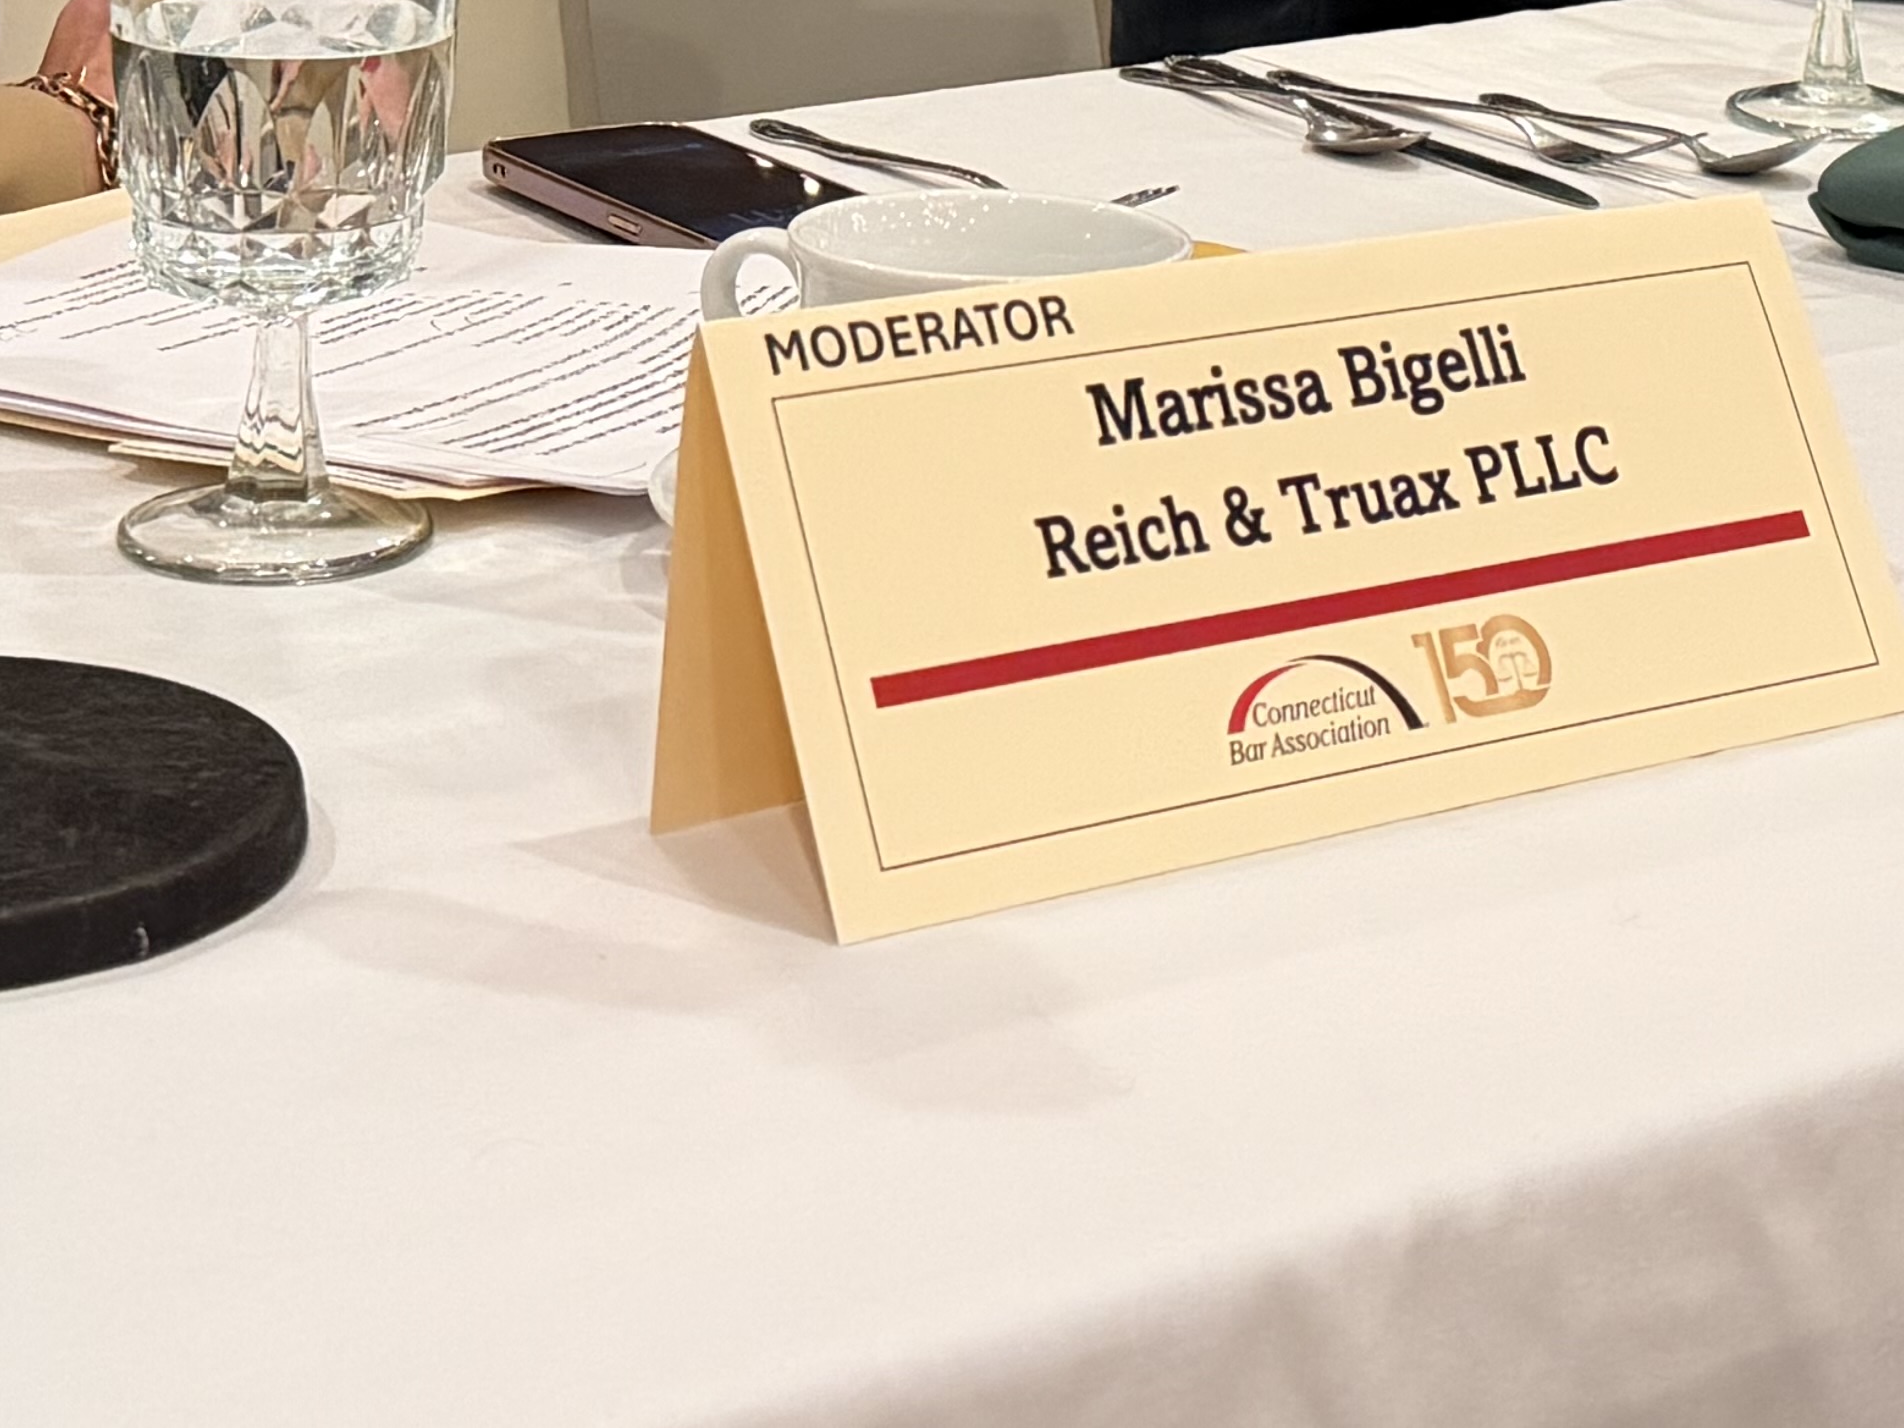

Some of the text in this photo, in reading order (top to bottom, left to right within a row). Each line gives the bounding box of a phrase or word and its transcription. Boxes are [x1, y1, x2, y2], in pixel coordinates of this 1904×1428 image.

[764, 295, 1074, 376] MODERATOR
[1085, 323, 1527, 446] Marissa Bigelli
[1034, 426, 1619, 579] Reich & Truax PLLC
[1251, 683, 1378, 727] Connecticut
[1410, 614, 1553, 724] 150
[1229, 716, 1391, 766] Bar Association
